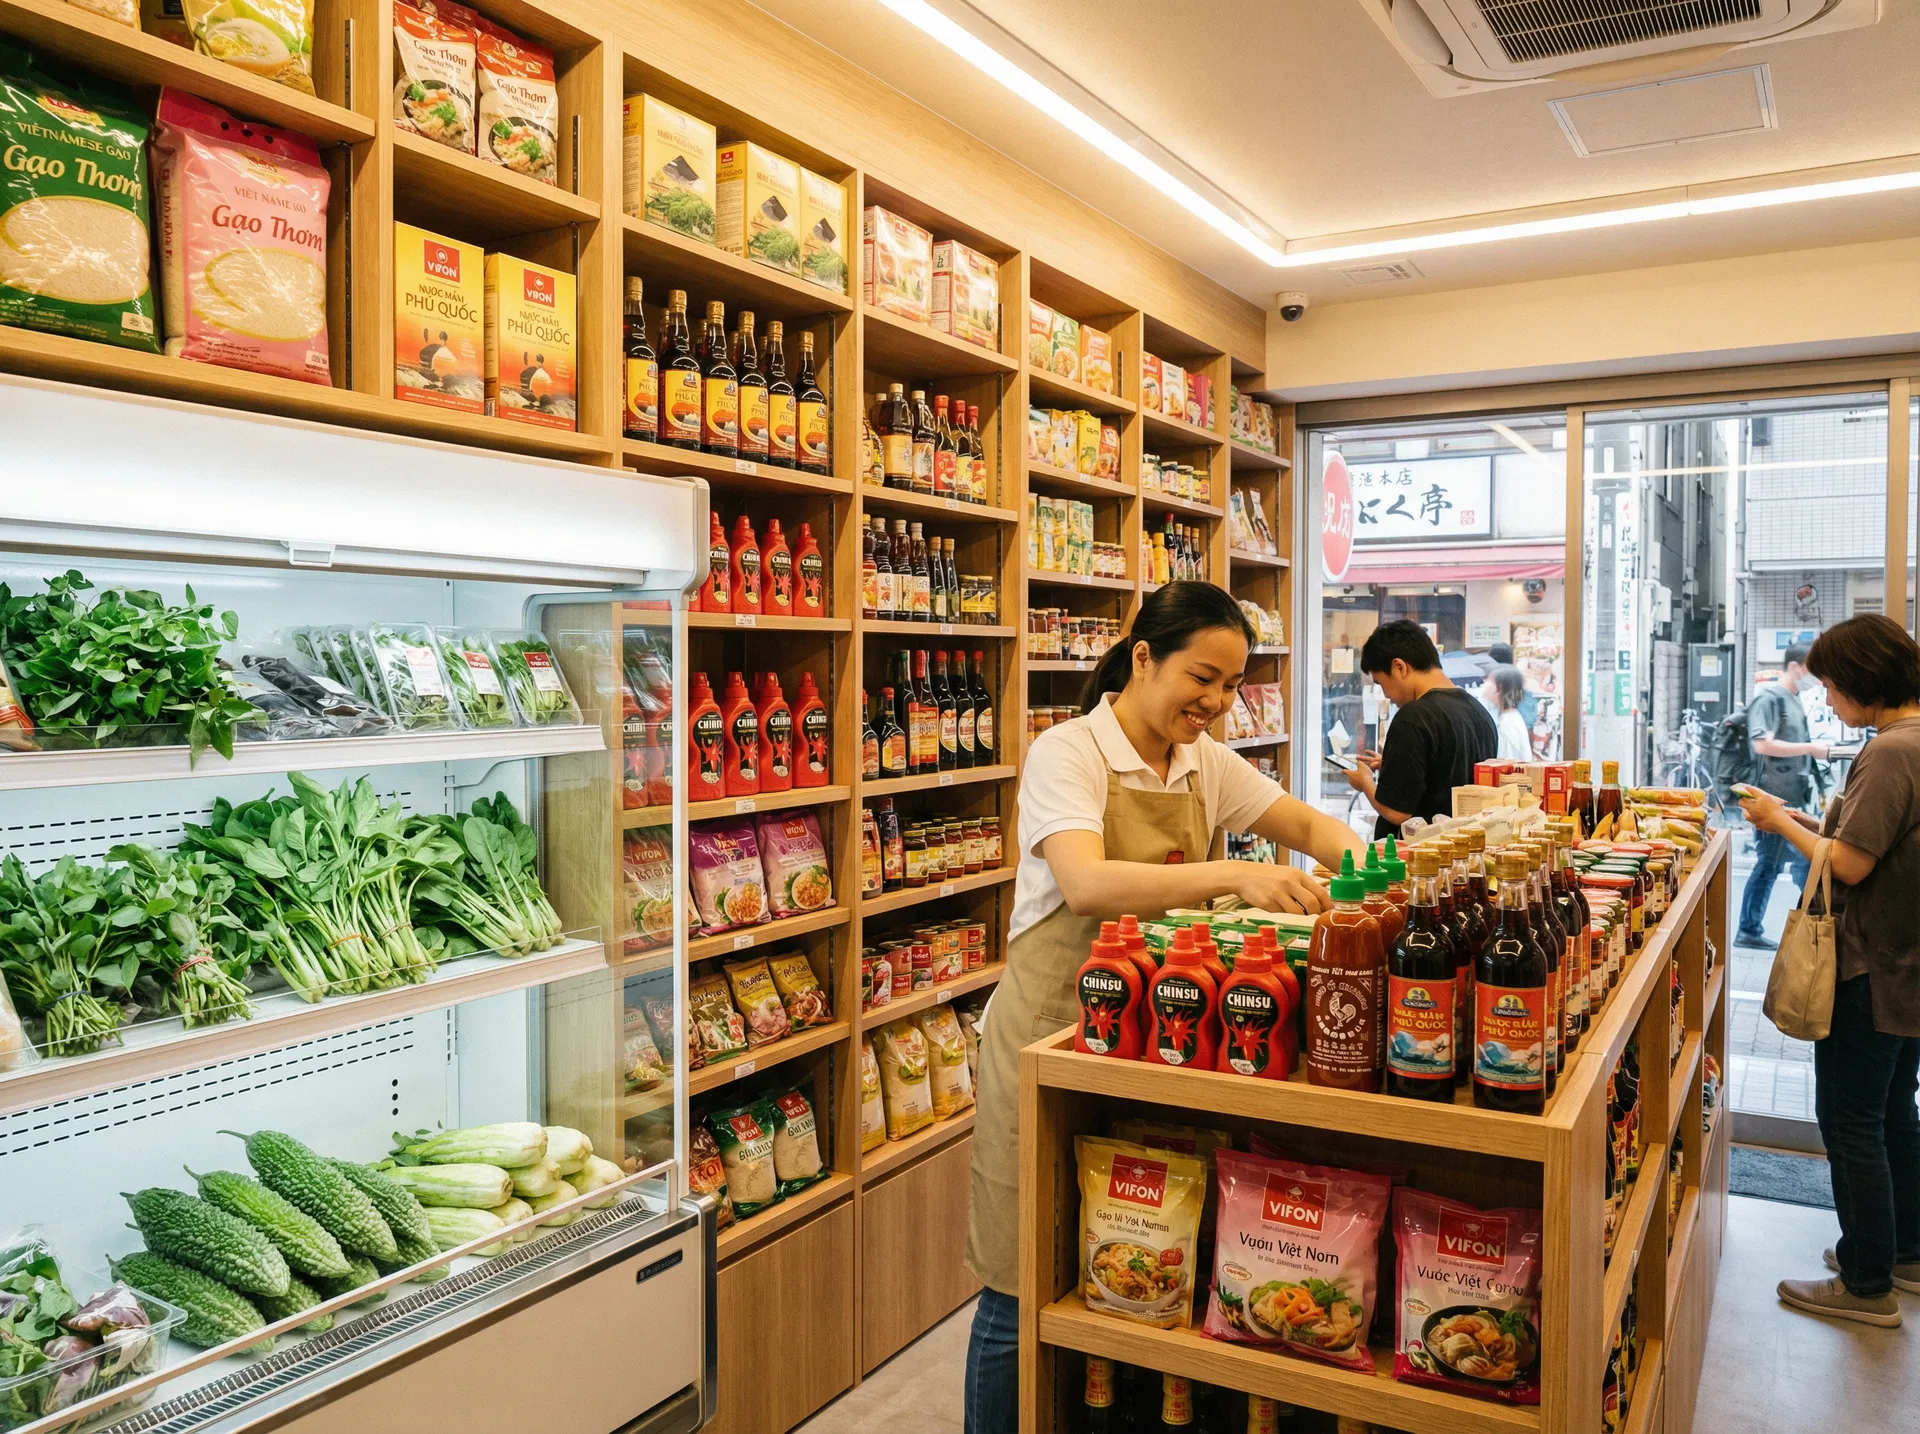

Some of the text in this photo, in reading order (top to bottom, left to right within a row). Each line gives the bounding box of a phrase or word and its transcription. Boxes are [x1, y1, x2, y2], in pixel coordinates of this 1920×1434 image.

[4, 144, 142, 200] Gạo Thơm
[212, 205, 322, 251] Gạo Thơm
[405, 292, 478, 323] PHÚ QUỐC
[508, 318, 532, 335] PHÚ
[1083, 976, 1122, 992] CHINSU
[1157, 984, 1199, 1000] CHINSU
[1227, 993, 1271, 1009] CHINSU
[1115, 1181, 1159, 1201] VIFON
[1269, 1201, 1319, 1225] VIFON
[1444, 1234, 1500, 1258] VIFON
